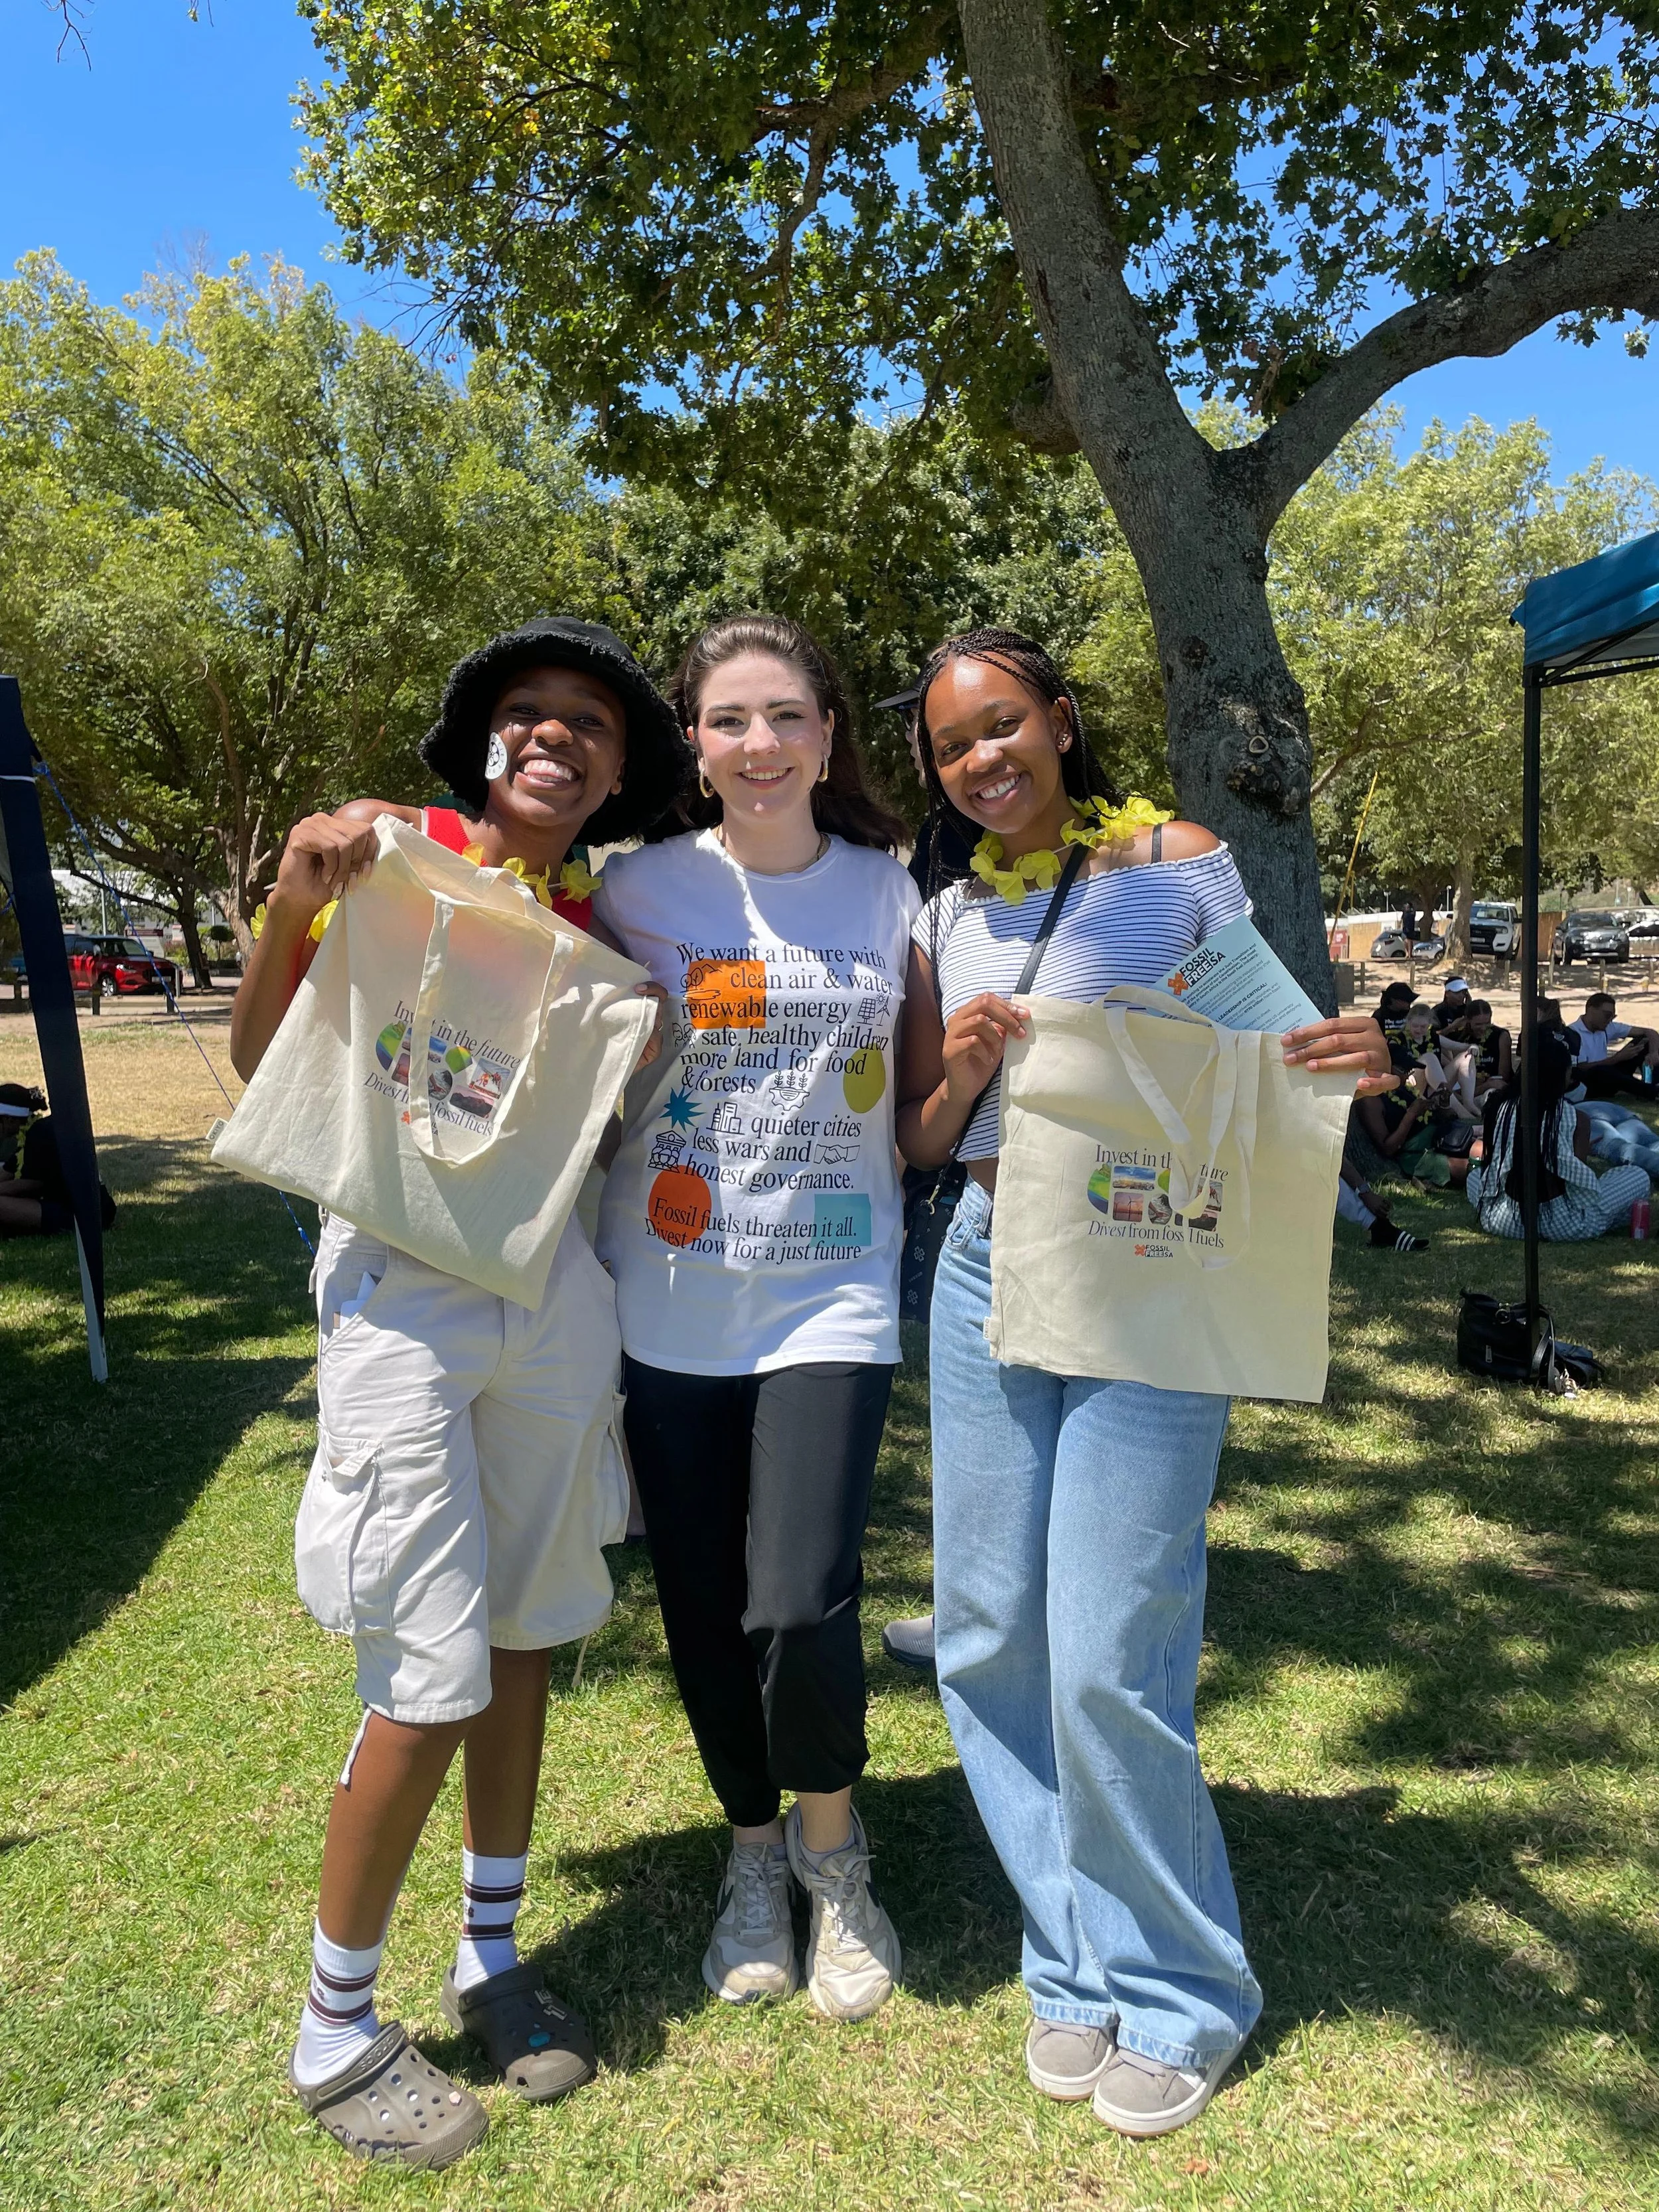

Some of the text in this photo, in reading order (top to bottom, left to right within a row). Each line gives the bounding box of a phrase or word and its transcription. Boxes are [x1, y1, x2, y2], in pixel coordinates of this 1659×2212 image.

[676, 942, 887, 970] We want a future with
[1179, 948, 1214, 977] FOSSIL
[1185, 951, 1226, 987] FREE SA
[731, 967, 893, 995] clean air & water
[681, 997, 852, 1025] renewable energy
[1217, 1000, 1242, 1020] LEADERSHIP
[437, 1019, 453, 1041] in
[454, 1029, 478, 1051] the
[471, 1039, 521, 1069] future
[701, 1025, 889, 1052] safe, healthy children
[681, 1045, 867, 1076] more land for food
[364, 1072, 404, 1102] Divest
[434, 1102, 466, 1126] fossil
[466, 1114, 493, 1136] fuels
[751, 1111, 861, 1140] quieter cities
[692, 1128, 812, 1163] less wars and
[1095, 1144, 1138, 1165] Invest
[1142, 1147, 1156, 1167] in
[684, 1153, 854, 1192] honest governance.
[653, 1197, 857, 1238] Fossil fuels threaten it all.
[644, 1217, 861, 1265] Divest now for a just future
[1088, 1220, 1224, 1248] Divest from fossl fuels
